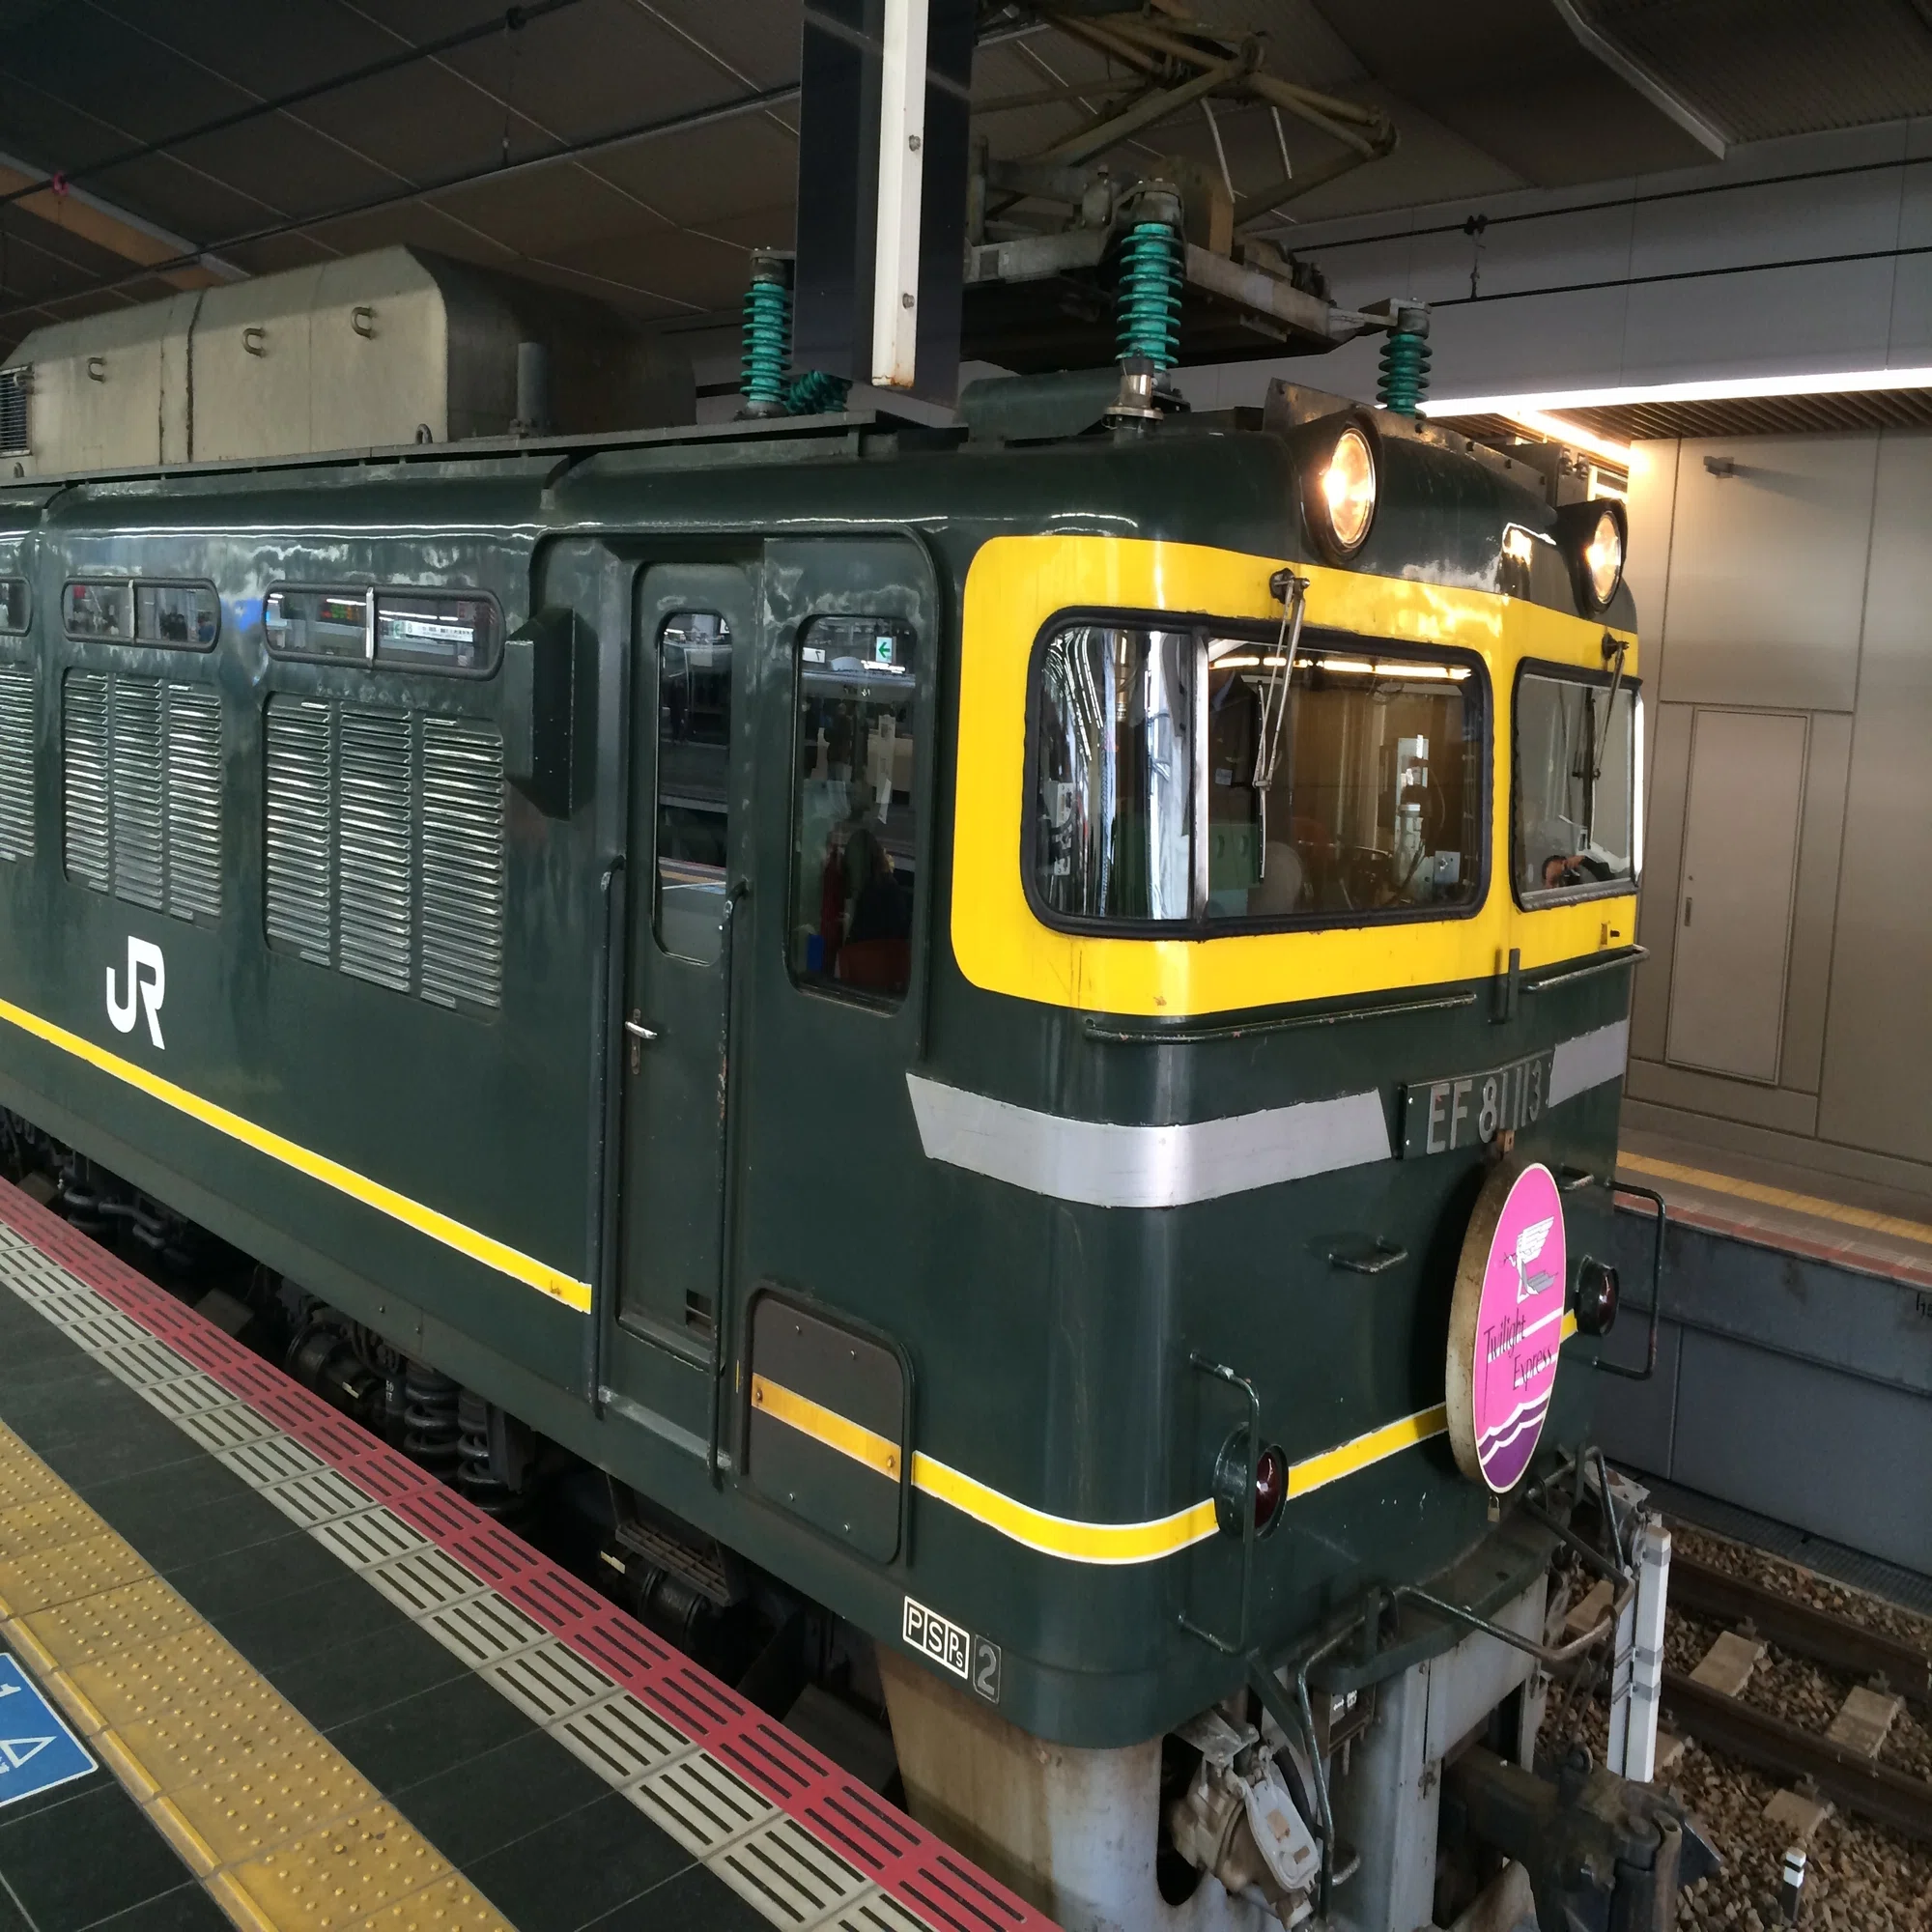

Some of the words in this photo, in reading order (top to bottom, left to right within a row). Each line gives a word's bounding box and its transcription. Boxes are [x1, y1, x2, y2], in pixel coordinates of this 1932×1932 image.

[106, 935, 165, 1050] JR
[1426, 1079, 1473, 1154] EF
[1484, 1308, 1526, 1386] Twilight
[1513, 1345, 1552, 1391] Express
[977, 1643, 997, 1695] 2
